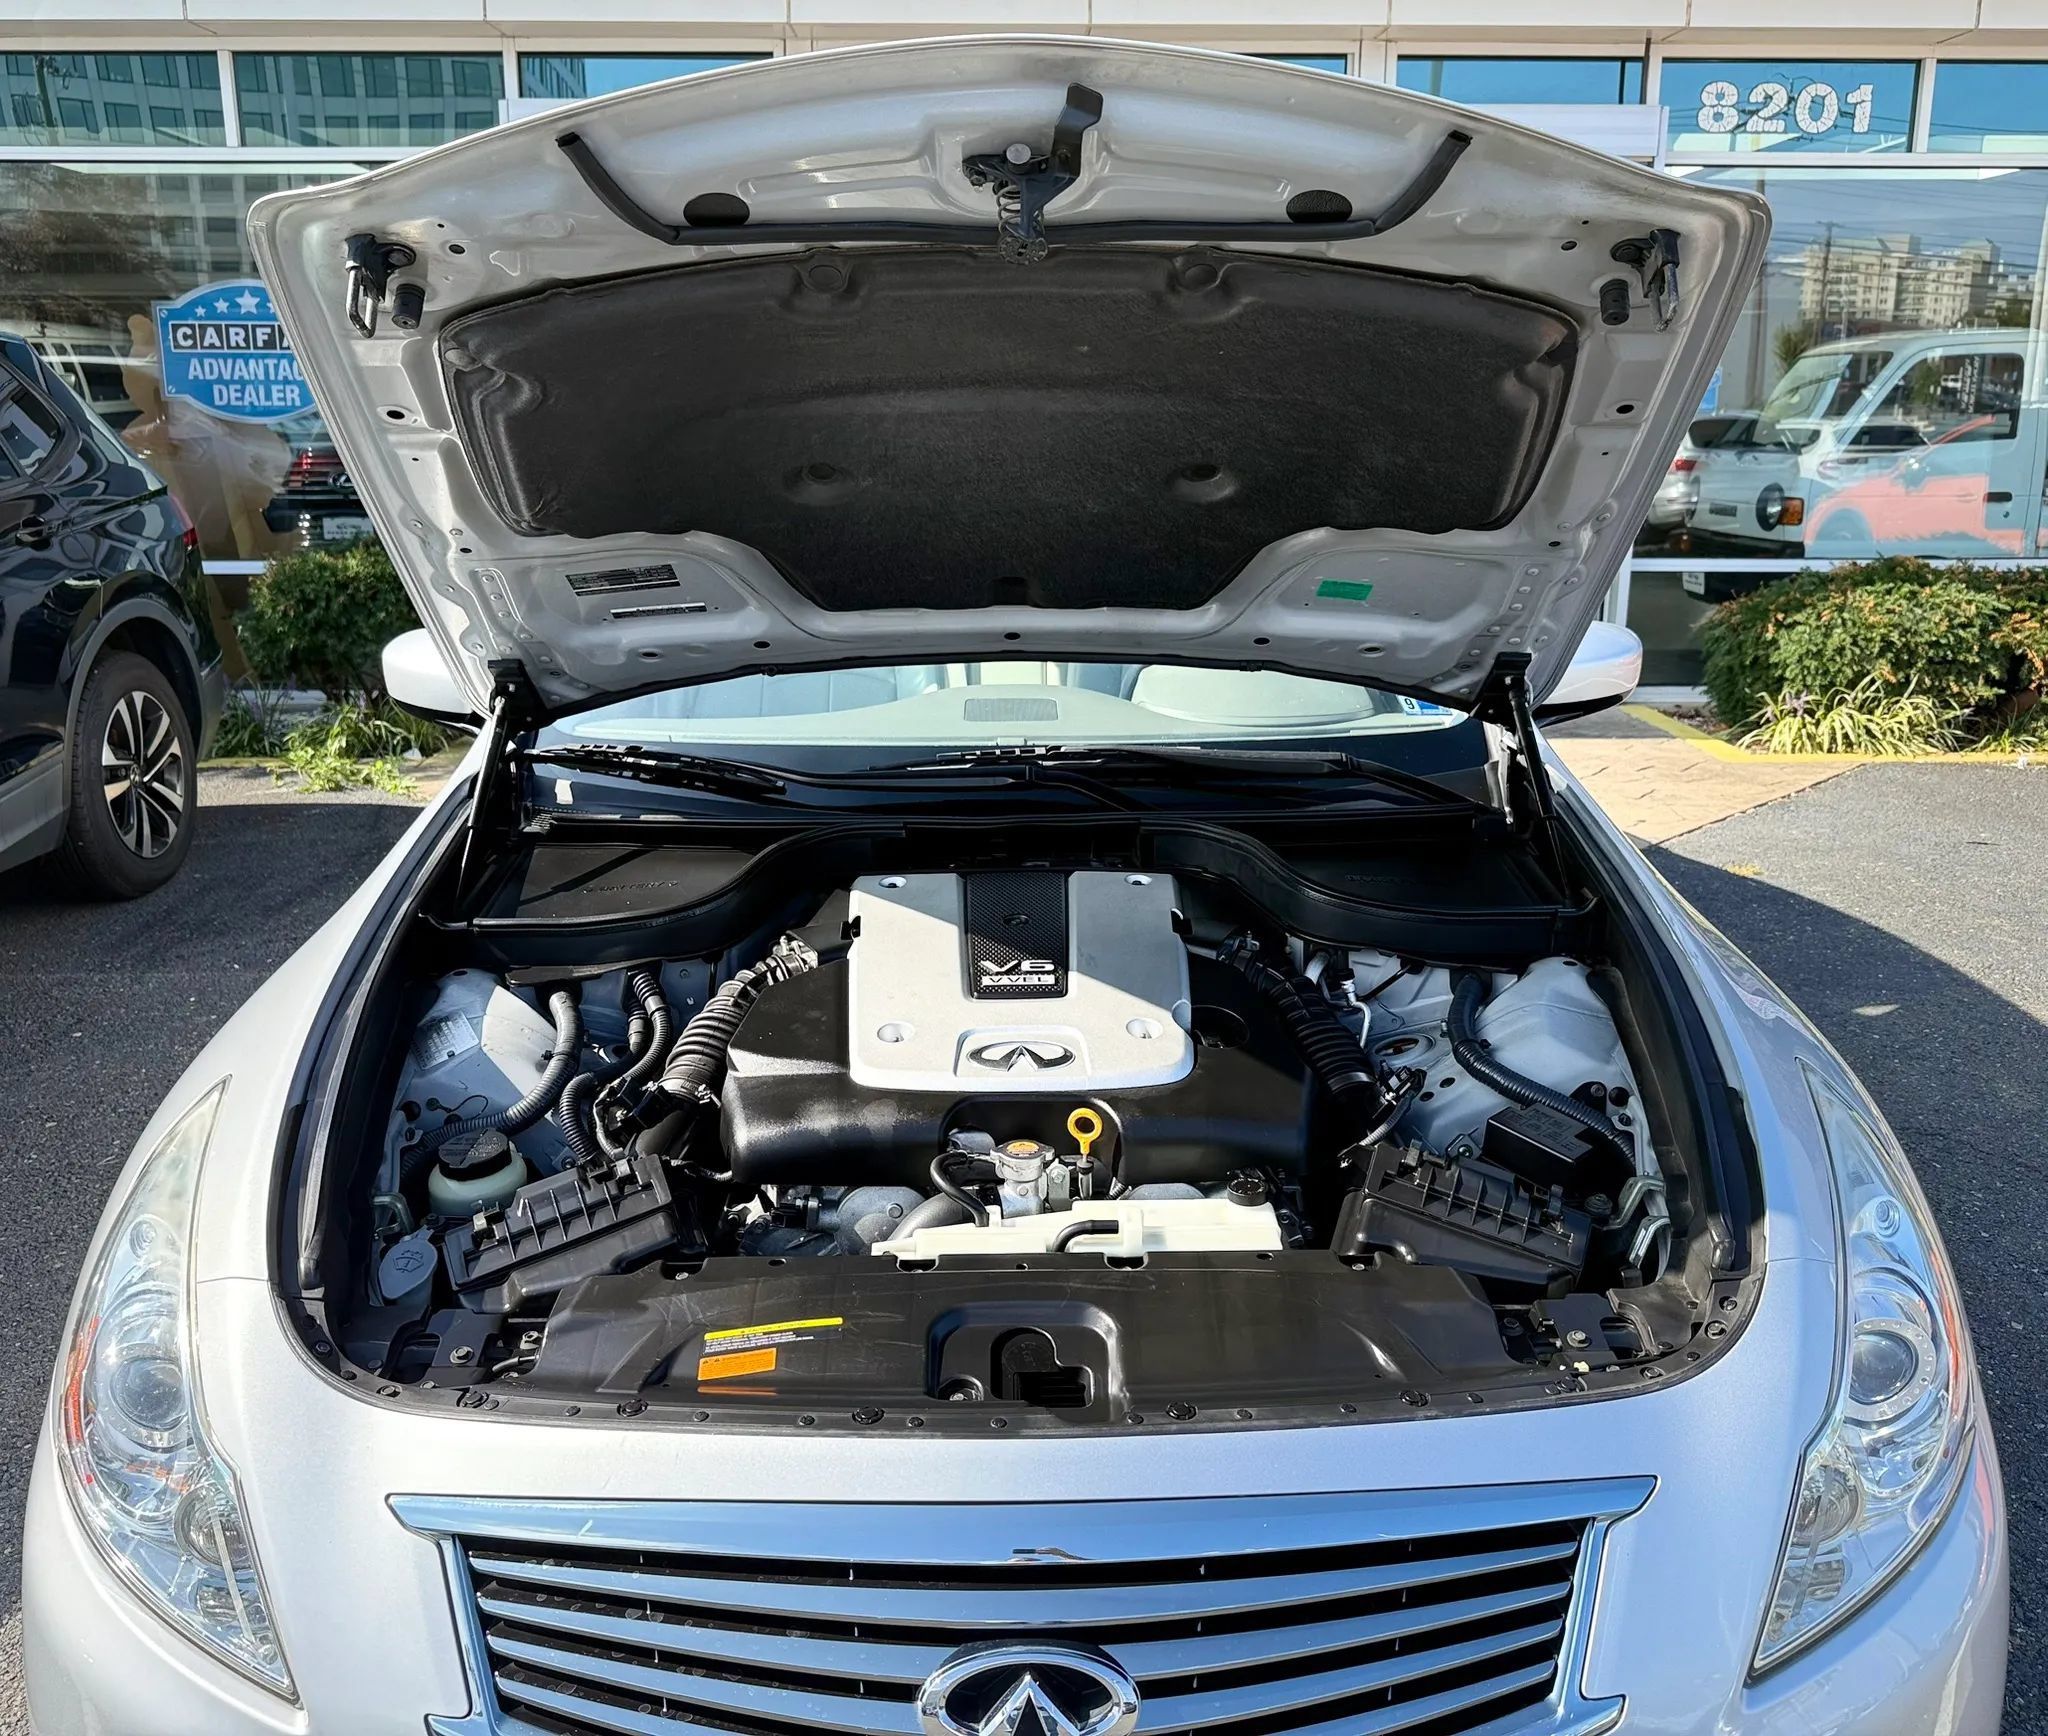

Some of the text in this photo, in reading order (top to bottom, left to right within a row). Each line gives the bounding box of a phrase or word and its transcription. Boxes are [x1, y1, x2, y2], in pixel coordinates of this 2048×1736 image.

[1697, 81, 1874, 134] 8201
[213, 384, 301, 406] DEALER
[980, 959, 1055, 973] V6
